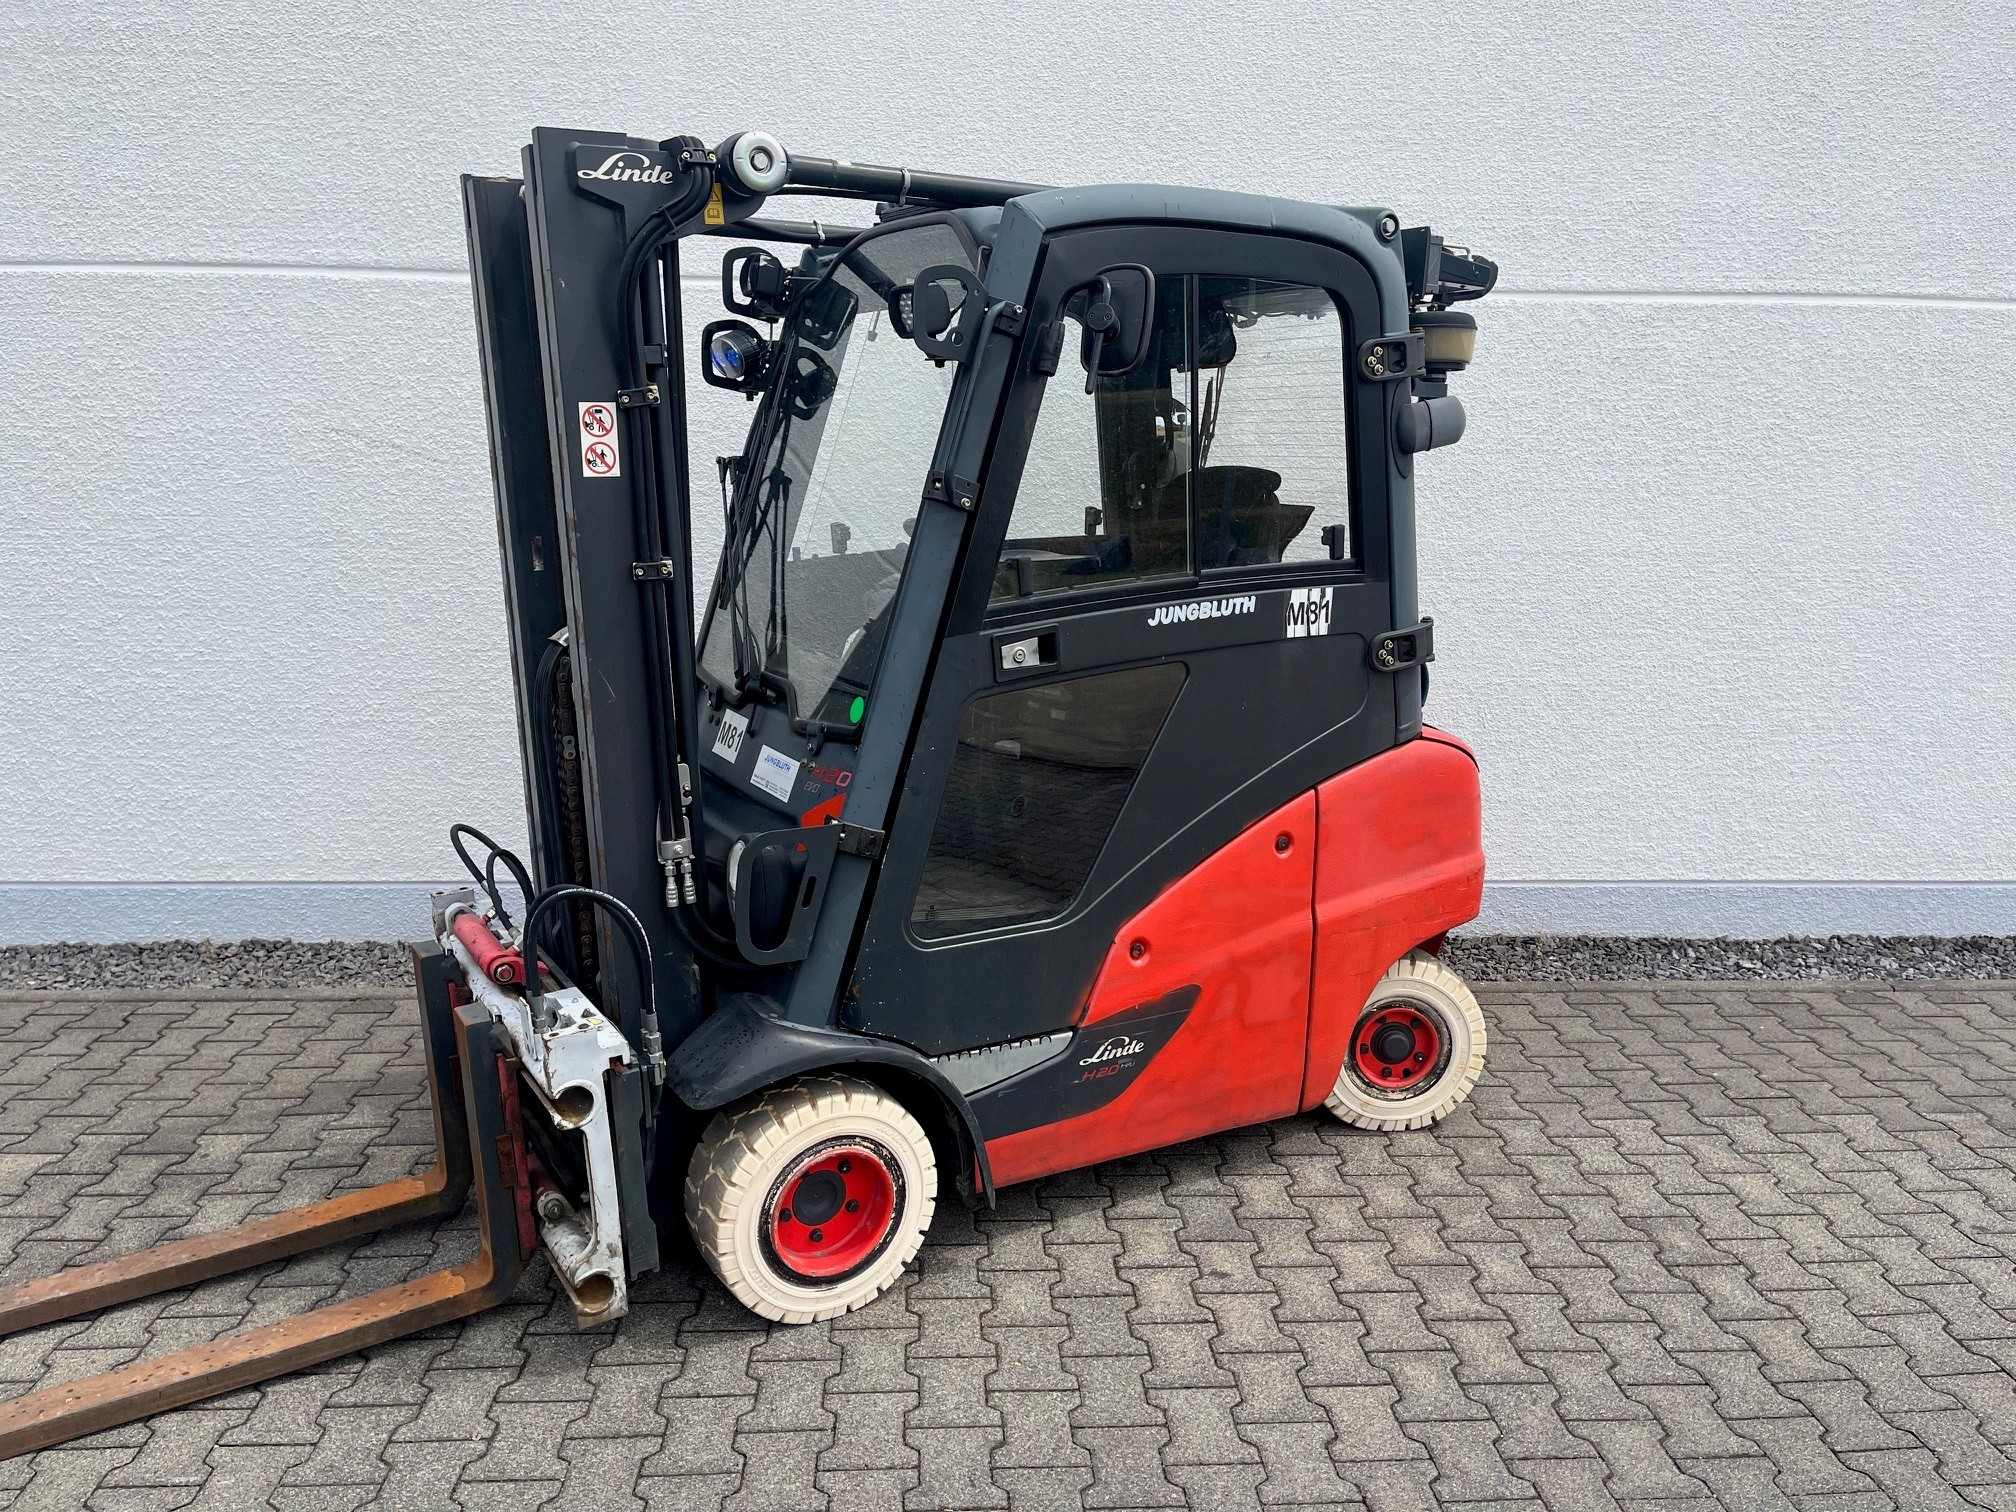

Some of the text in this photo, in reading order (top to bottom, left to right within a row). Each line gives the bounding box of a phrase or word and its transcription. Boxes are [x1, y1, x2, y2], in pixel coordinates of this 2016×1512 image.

[577, 152, 674, 184] Linde
[1147, 596, 1256, 627] JUNGBLUTH
[1286, 600, 1331, 627] M81
[717, 721, 743, 752] M81
[764, 754, 791, 772] JUNGBLUTH
[1079, 1036, 1144, 1066] Linde
[1082, 1064, 1120, 1080] H20
